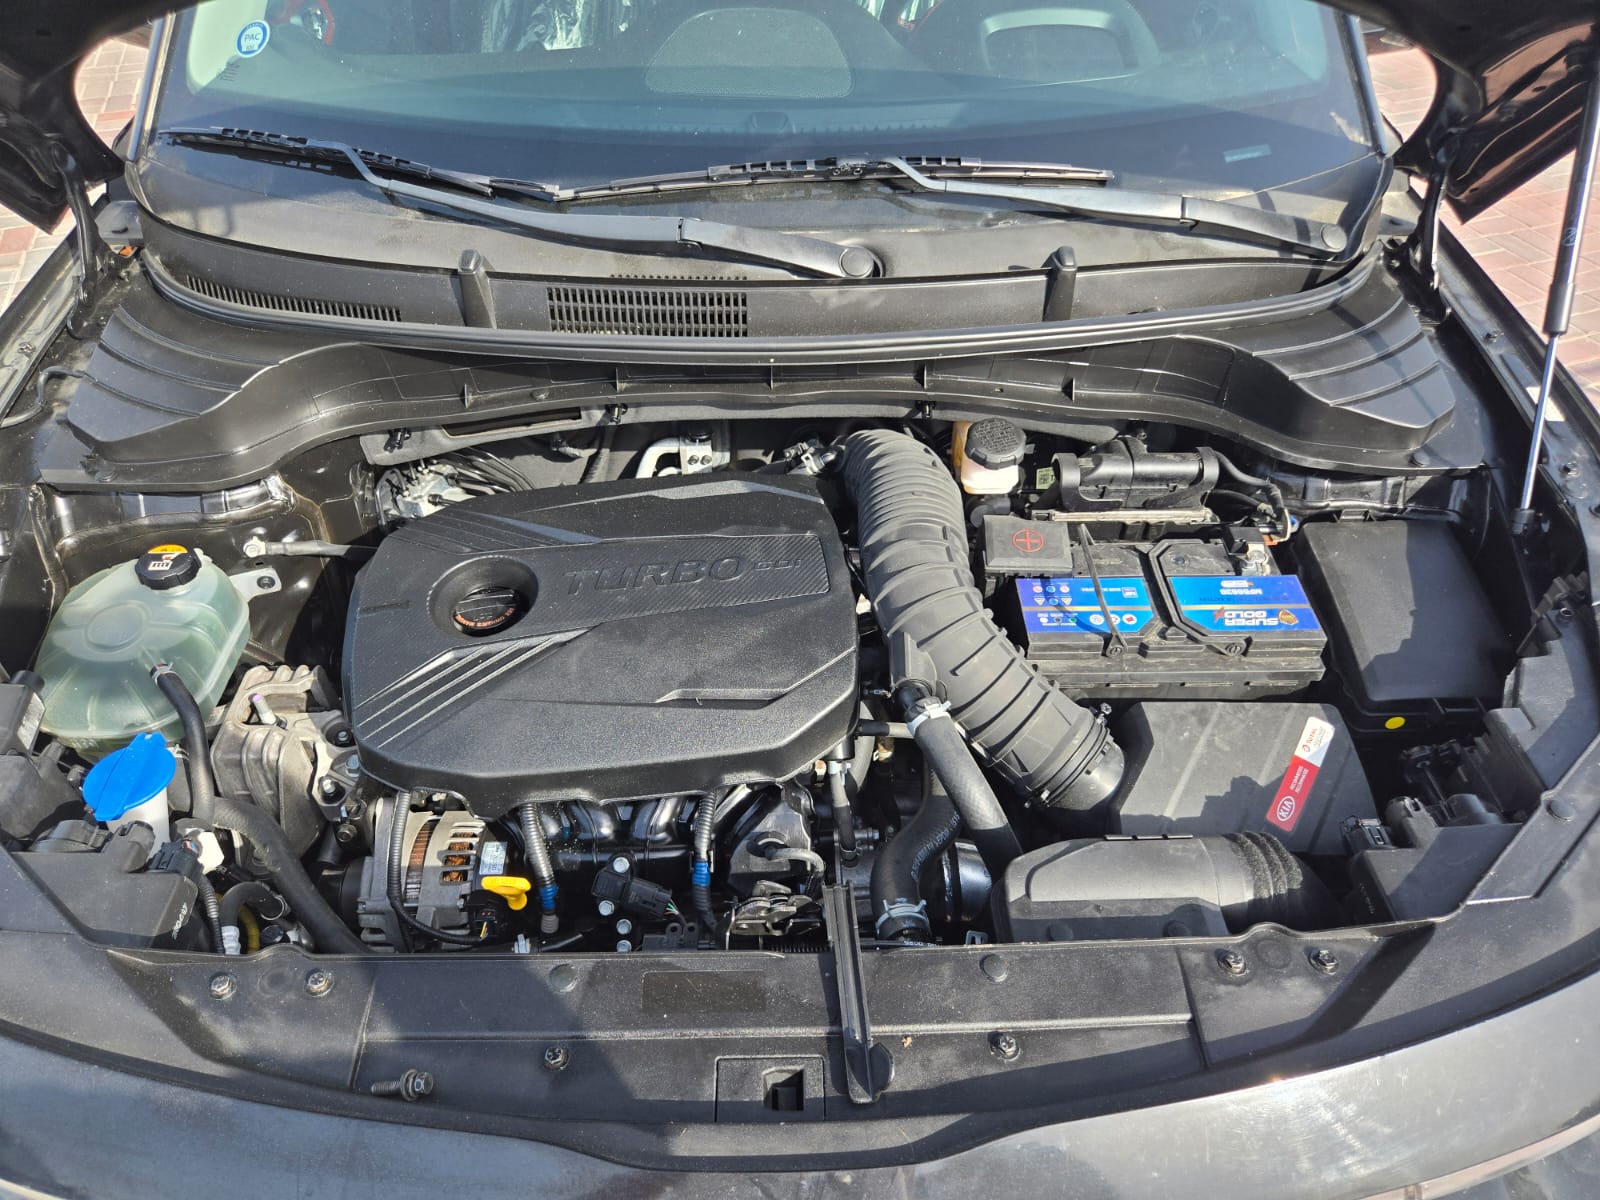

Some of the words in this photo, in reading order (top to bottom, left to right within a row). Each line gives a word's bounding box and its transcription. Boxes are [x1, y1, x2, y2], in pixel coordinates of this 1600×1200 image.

[244, 32, 262, 42] PAC
[564, 556, 746, 595] TURBO
[1223, 610, 1268, 619] GOLD
[1224, 617, 1279, 627] SUPER
[1279, 800, 1293, 818] KIA
